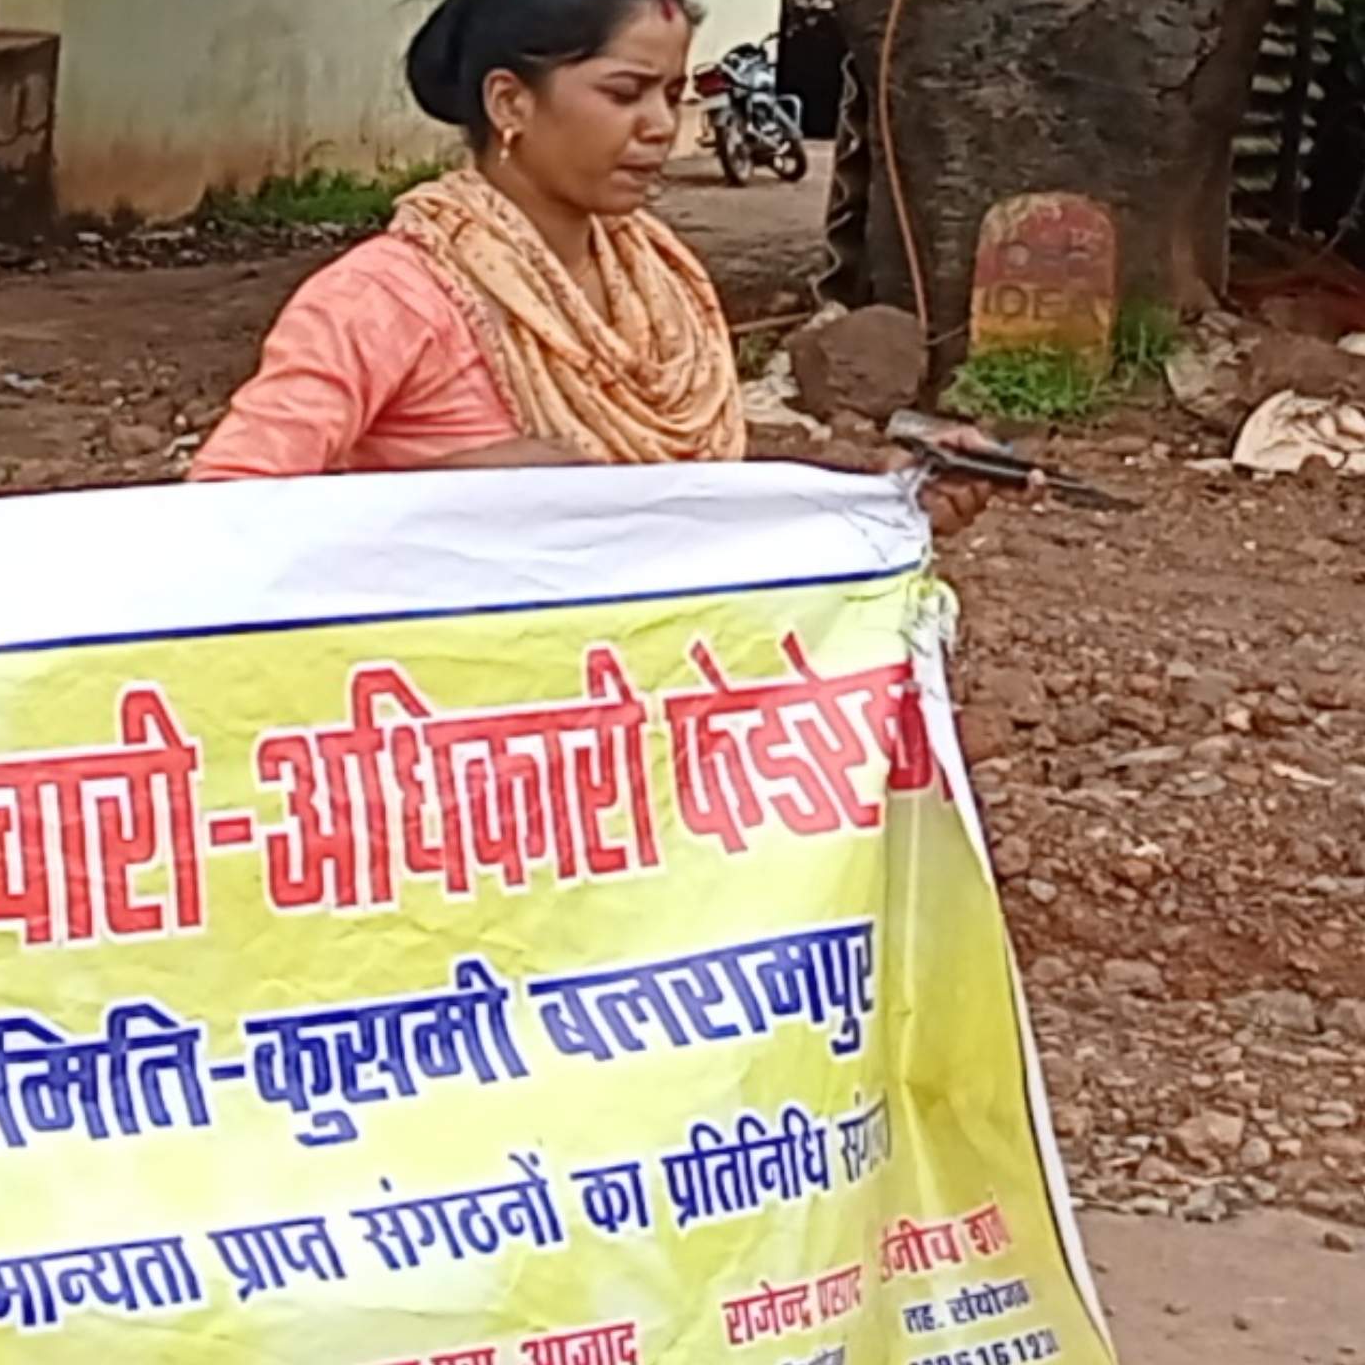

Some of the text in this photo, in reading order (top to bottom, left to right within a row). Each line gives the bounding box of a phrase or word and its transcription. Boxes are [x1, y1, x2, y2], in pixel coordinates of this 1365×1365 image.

[208, 1216, 346, 1303] प्राप्त
[351, 1153, 563, 1271] संगठनों
[571, 1161, 650, 1235] का
[662, 1107, 829, 1228] प्रतिनिधि
